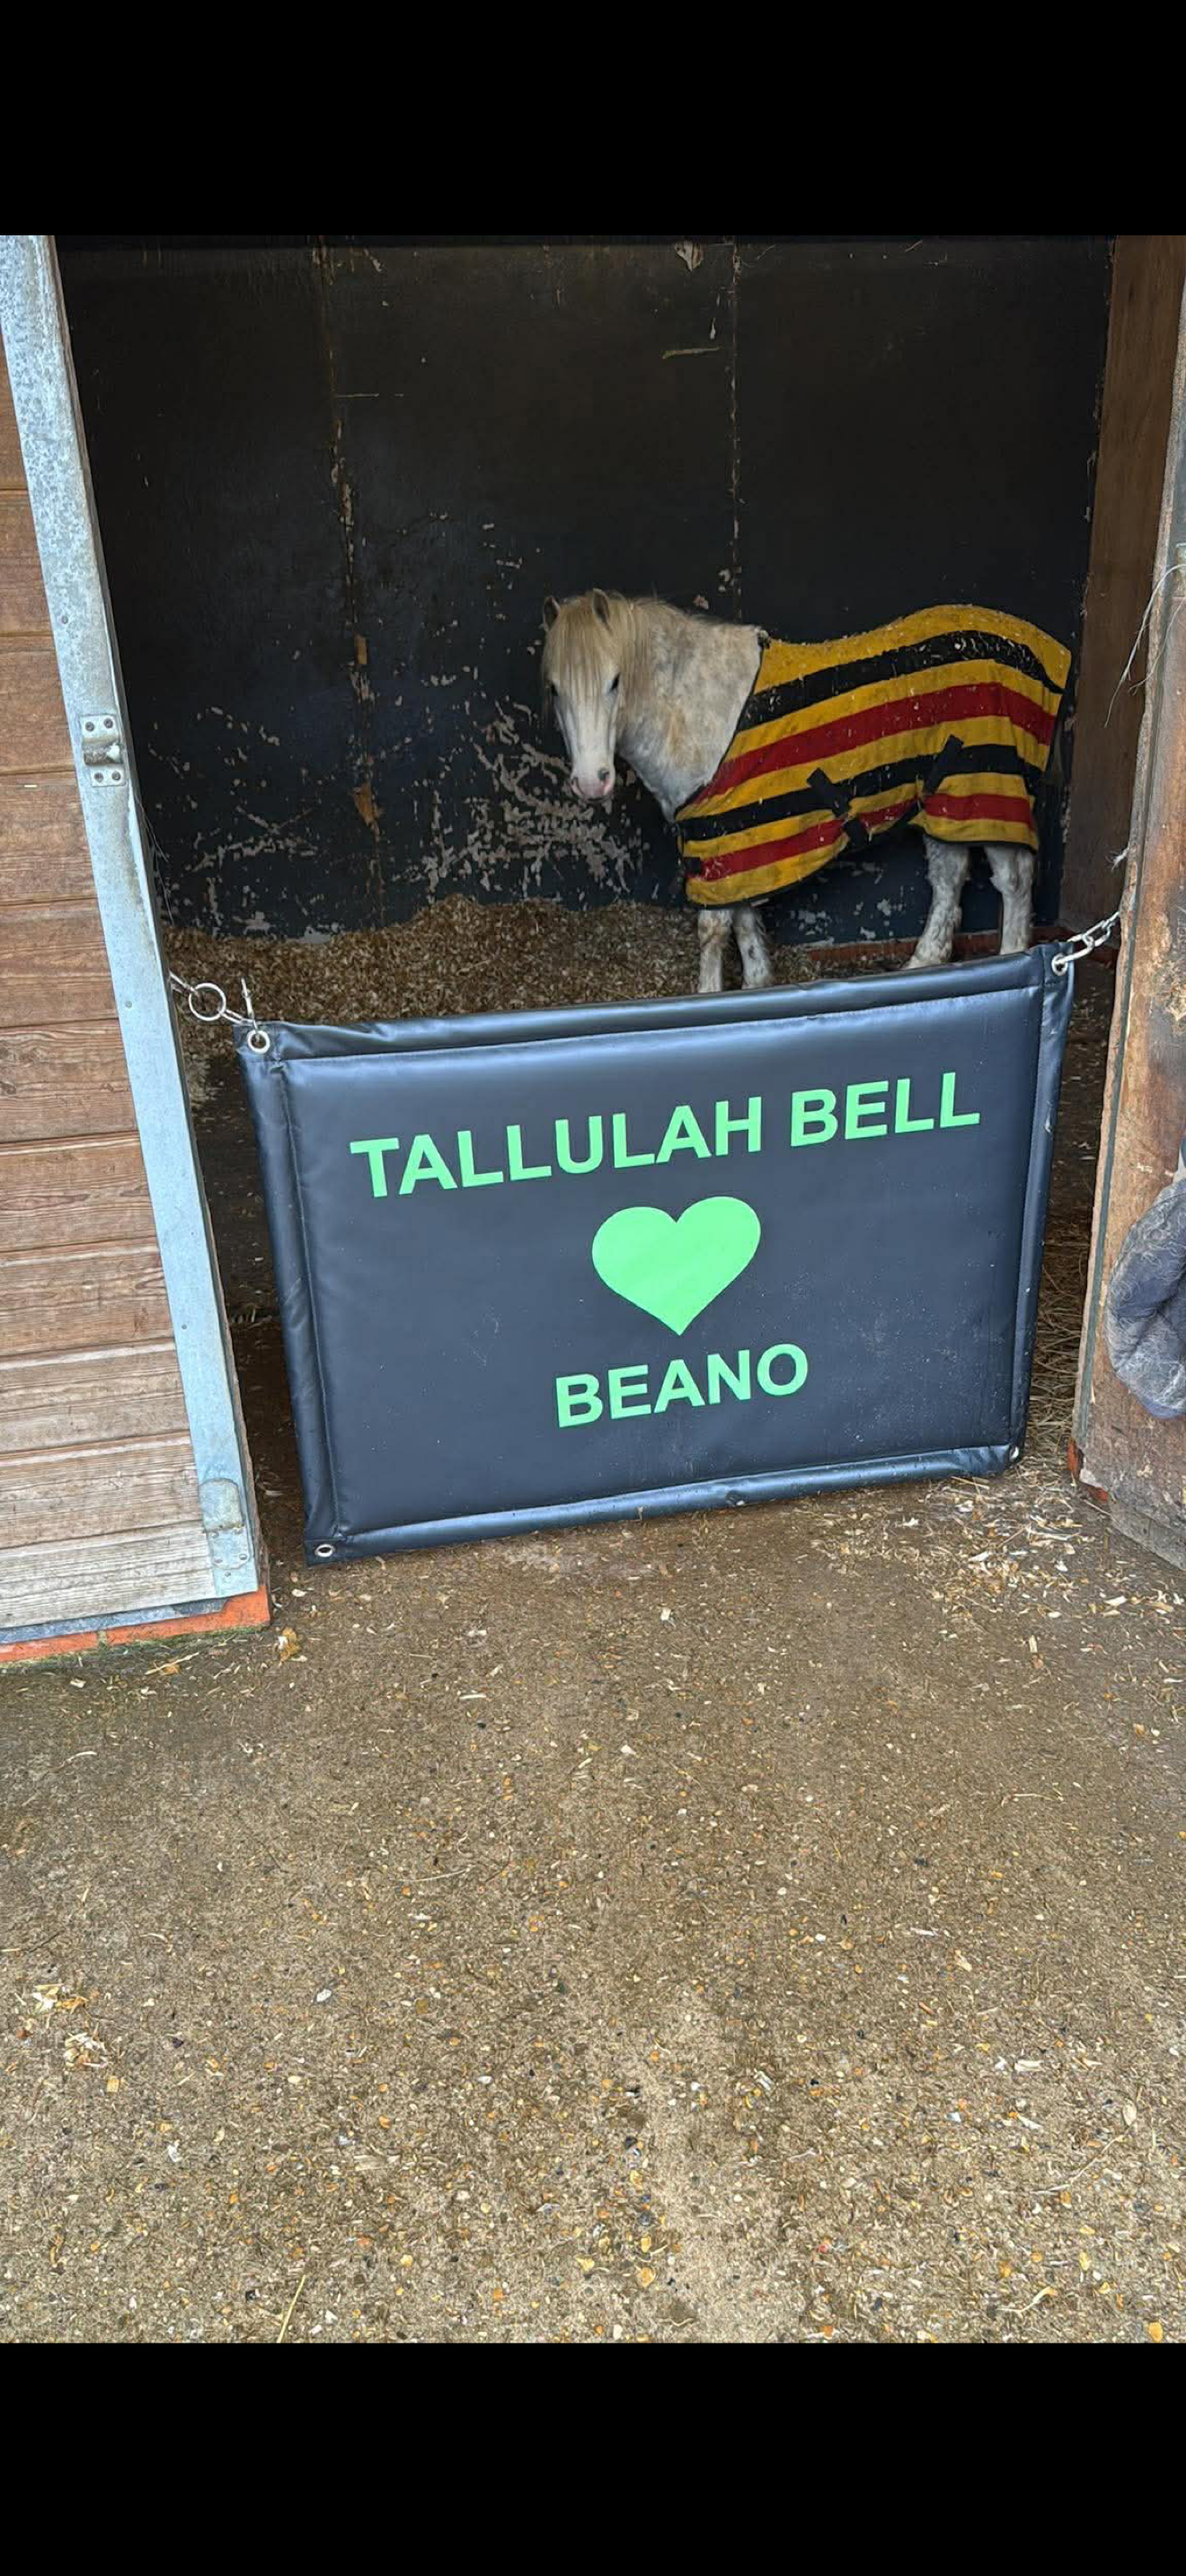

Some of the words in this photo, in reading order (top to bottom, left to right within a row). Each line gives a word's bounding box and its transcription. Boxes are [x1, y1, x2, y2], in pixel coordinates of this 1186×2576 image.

[350, 1096, 764, 1198] TALLULAH
[790, 1072, 980, 1148] BELL
[554, 1344, 809, 1427] BEANO
